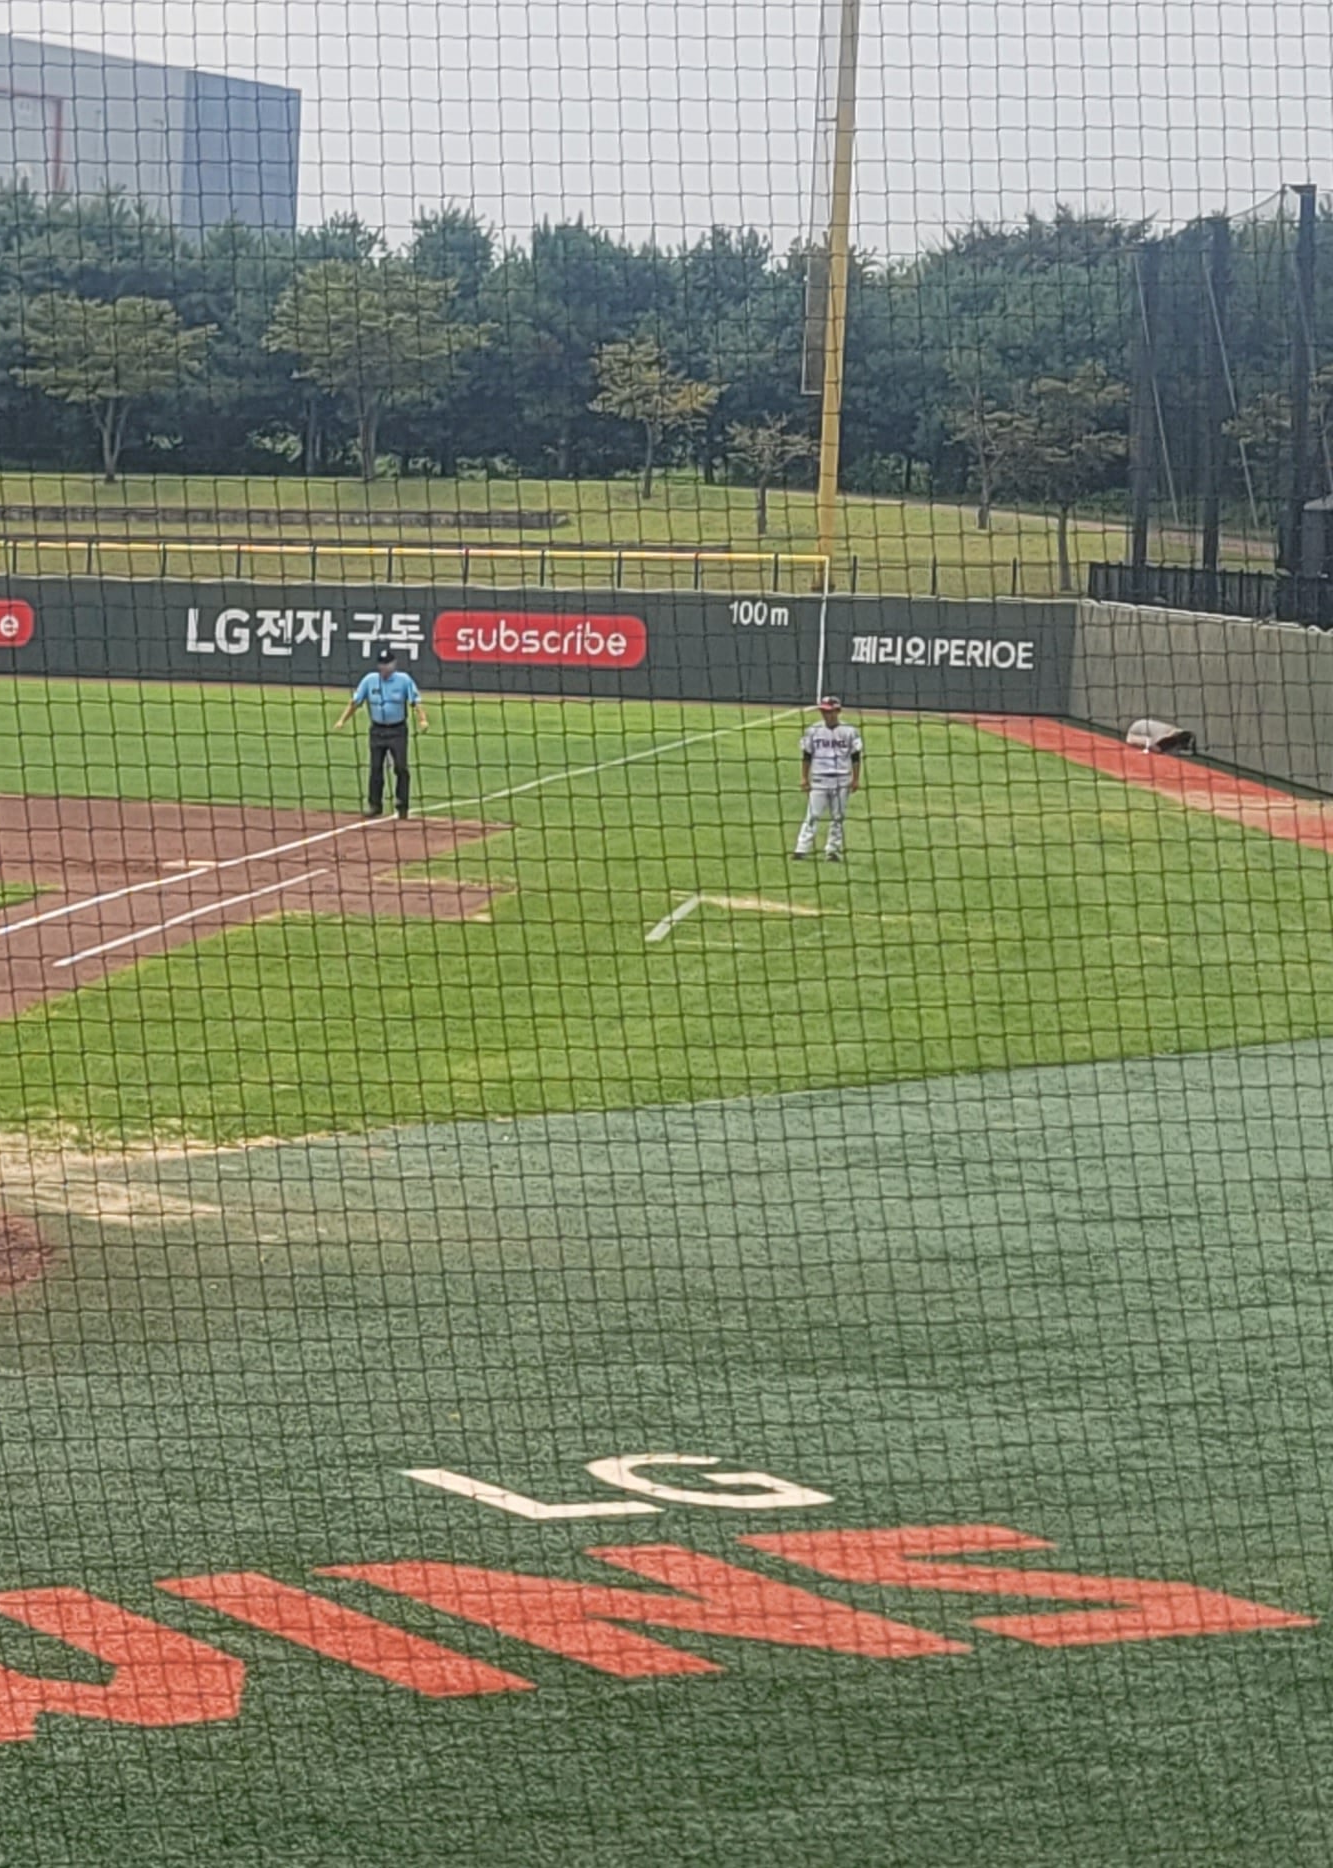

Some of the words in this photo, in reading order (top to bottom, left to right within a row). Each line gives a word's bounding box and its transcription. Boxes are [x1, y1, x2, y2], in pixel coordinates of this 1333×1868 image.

[187, 608, 337, 657] LG전자
[347, 613, 424, 660] 구독
[456, 621, 627, 656] subscribe
[934, 639, 1033, 669] PERIOE
[403, 1452, 835, 1520] LG
